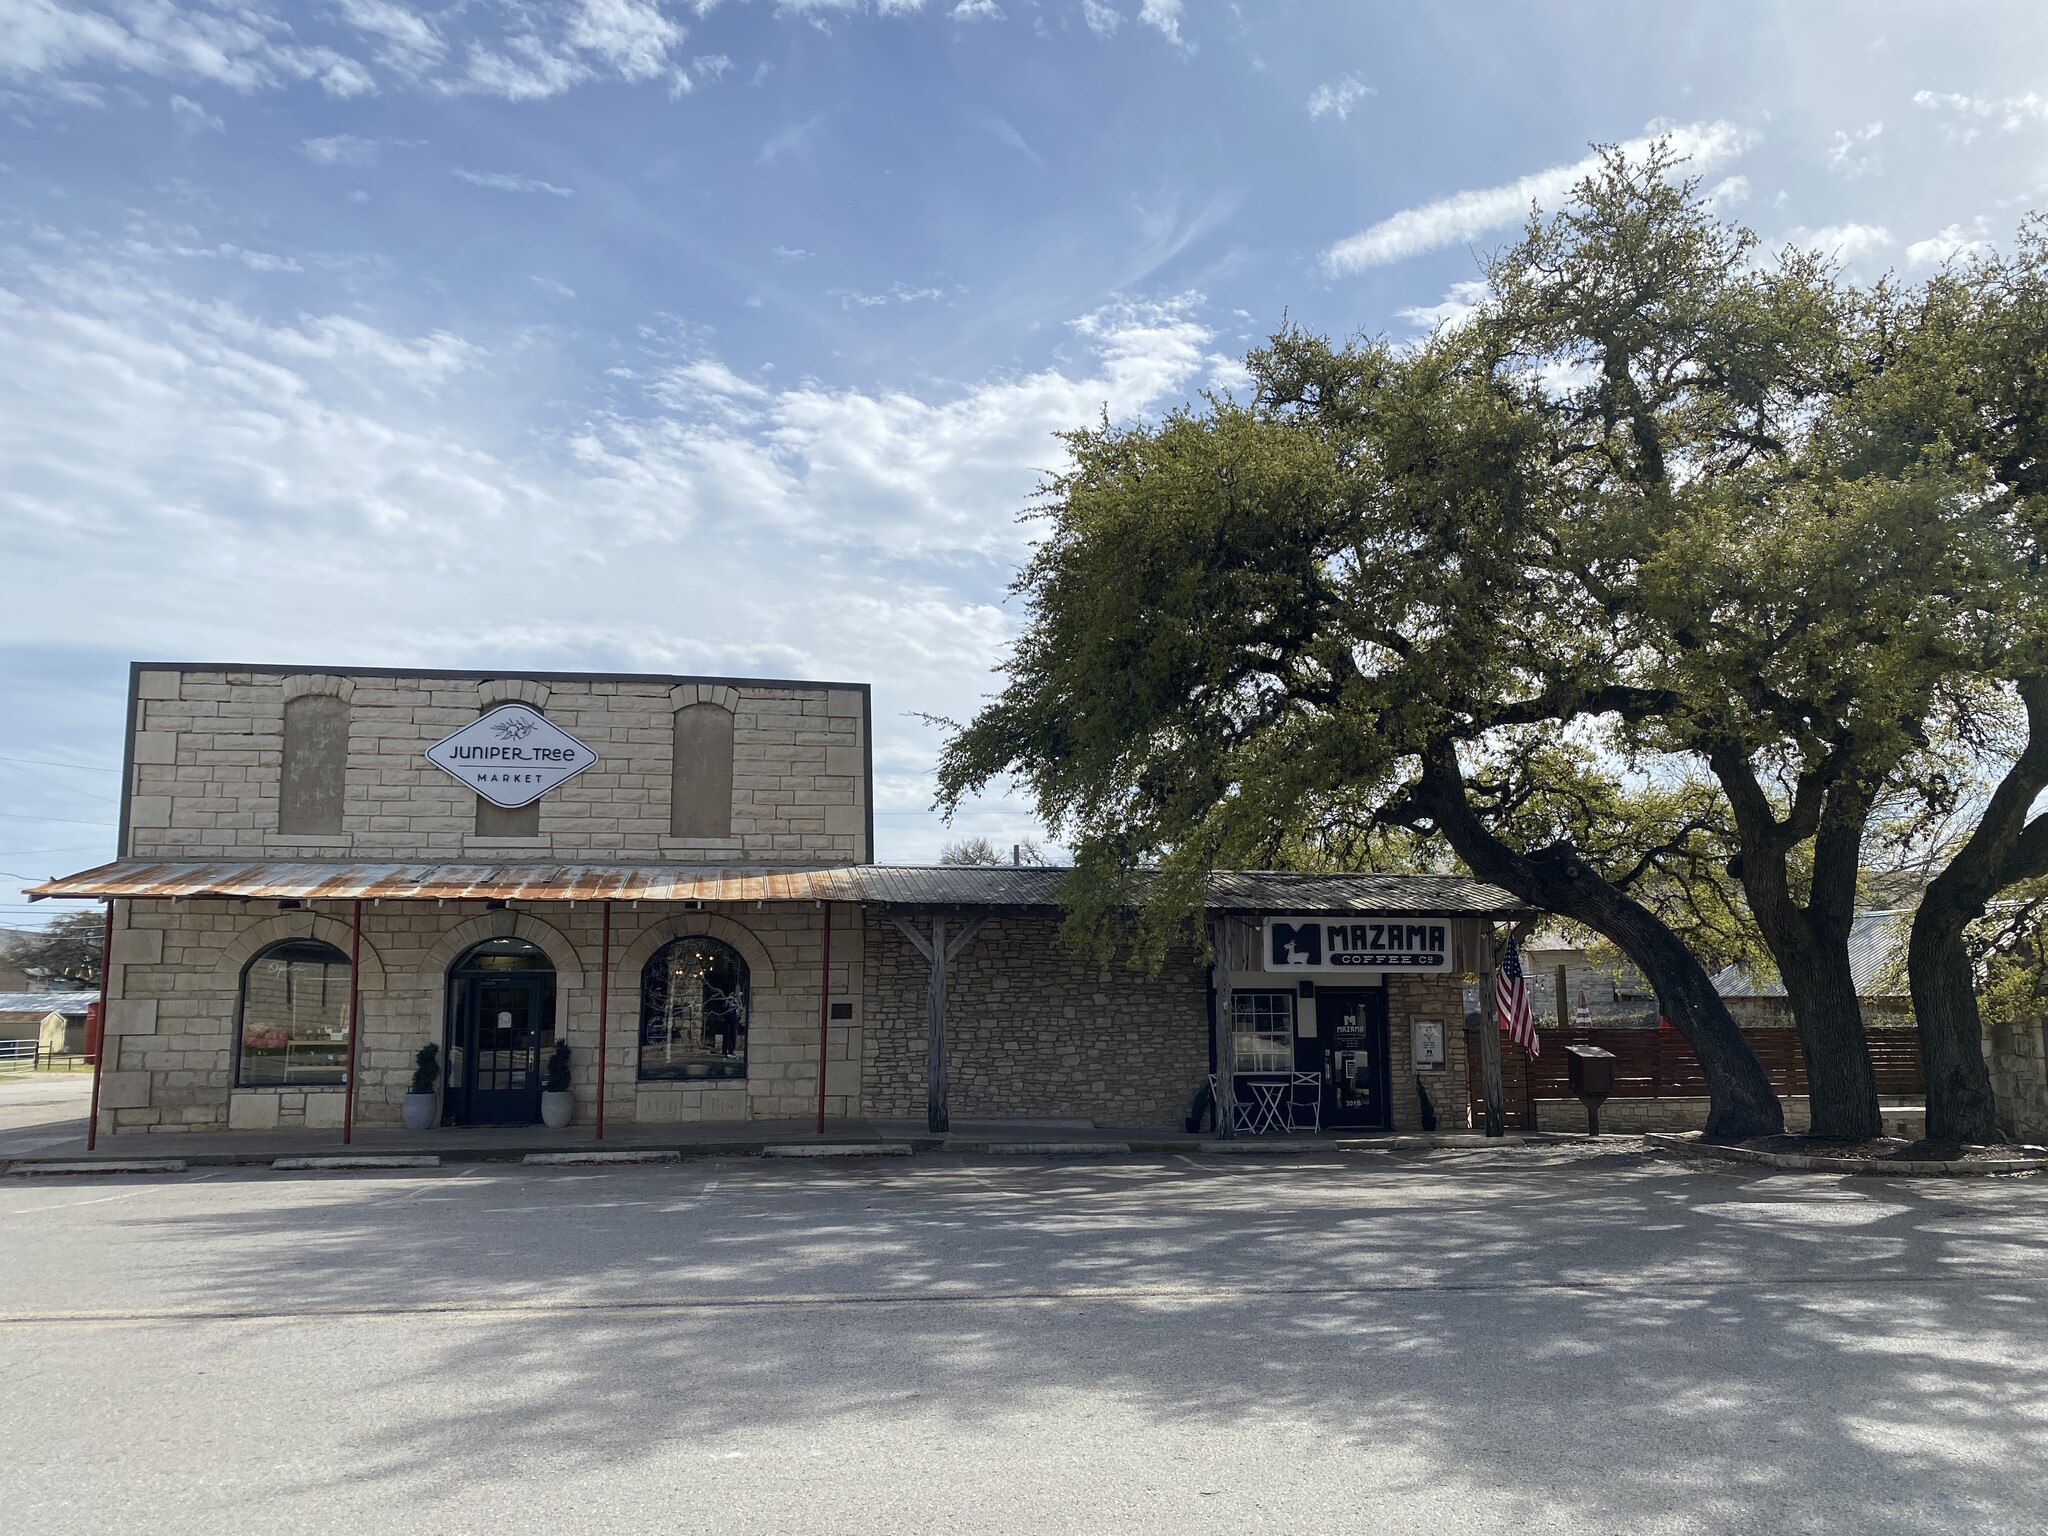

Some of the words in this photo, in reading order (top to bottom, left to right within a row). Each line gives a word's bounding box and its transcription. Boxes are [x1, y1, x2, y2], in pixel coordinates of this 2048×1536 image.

[477, 773, 542, 783] MARKET
[1327, 924, 1445, 951] MAZAMA
[1341, 955, 1412, 964] COFFEE
[267, 962, 307, 979] Open
[1336, 1026, 1364, 1034] MAZAMA
